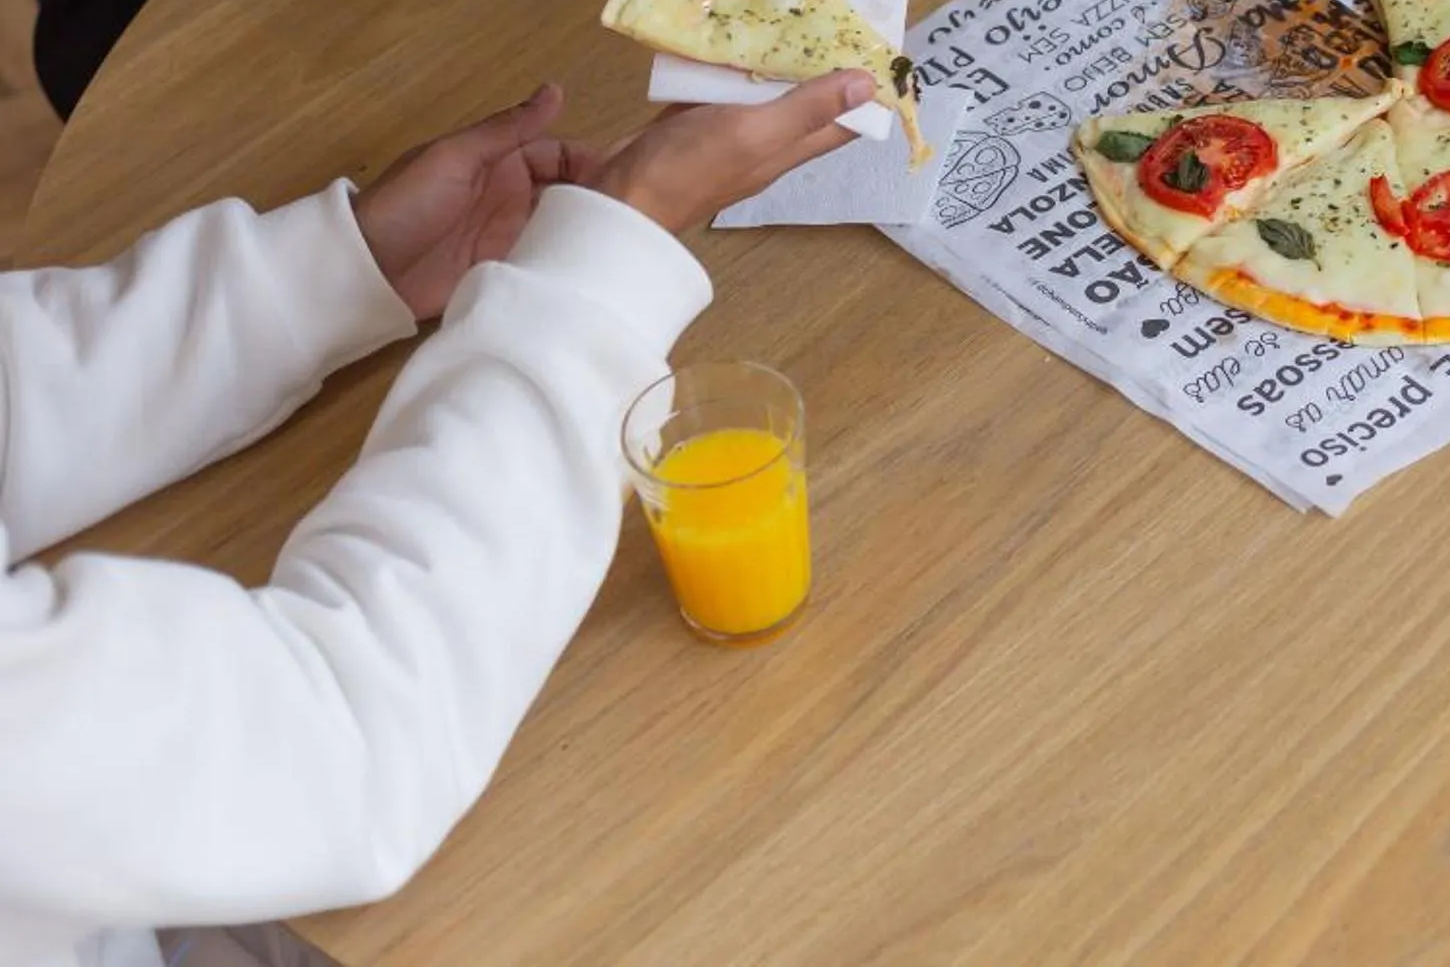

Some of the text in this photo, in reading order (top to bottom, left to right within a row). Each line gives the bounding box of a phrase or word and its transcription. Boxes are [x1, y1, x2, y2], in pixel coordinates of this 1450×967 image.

[912, 46, 976, 87] PIZ
[1018, 26, 1071, 64] SEM
[1056, 17, 1126, 66] como
[1063, 13, 1188, 92] SEM BEIJO
[1090, 26, 1227, 115] Amor
[1182, 330, 1281, 404] se elas
[1284, 345, 1405, 433] amar as
[1300, 375, 1432, 468] preciso
